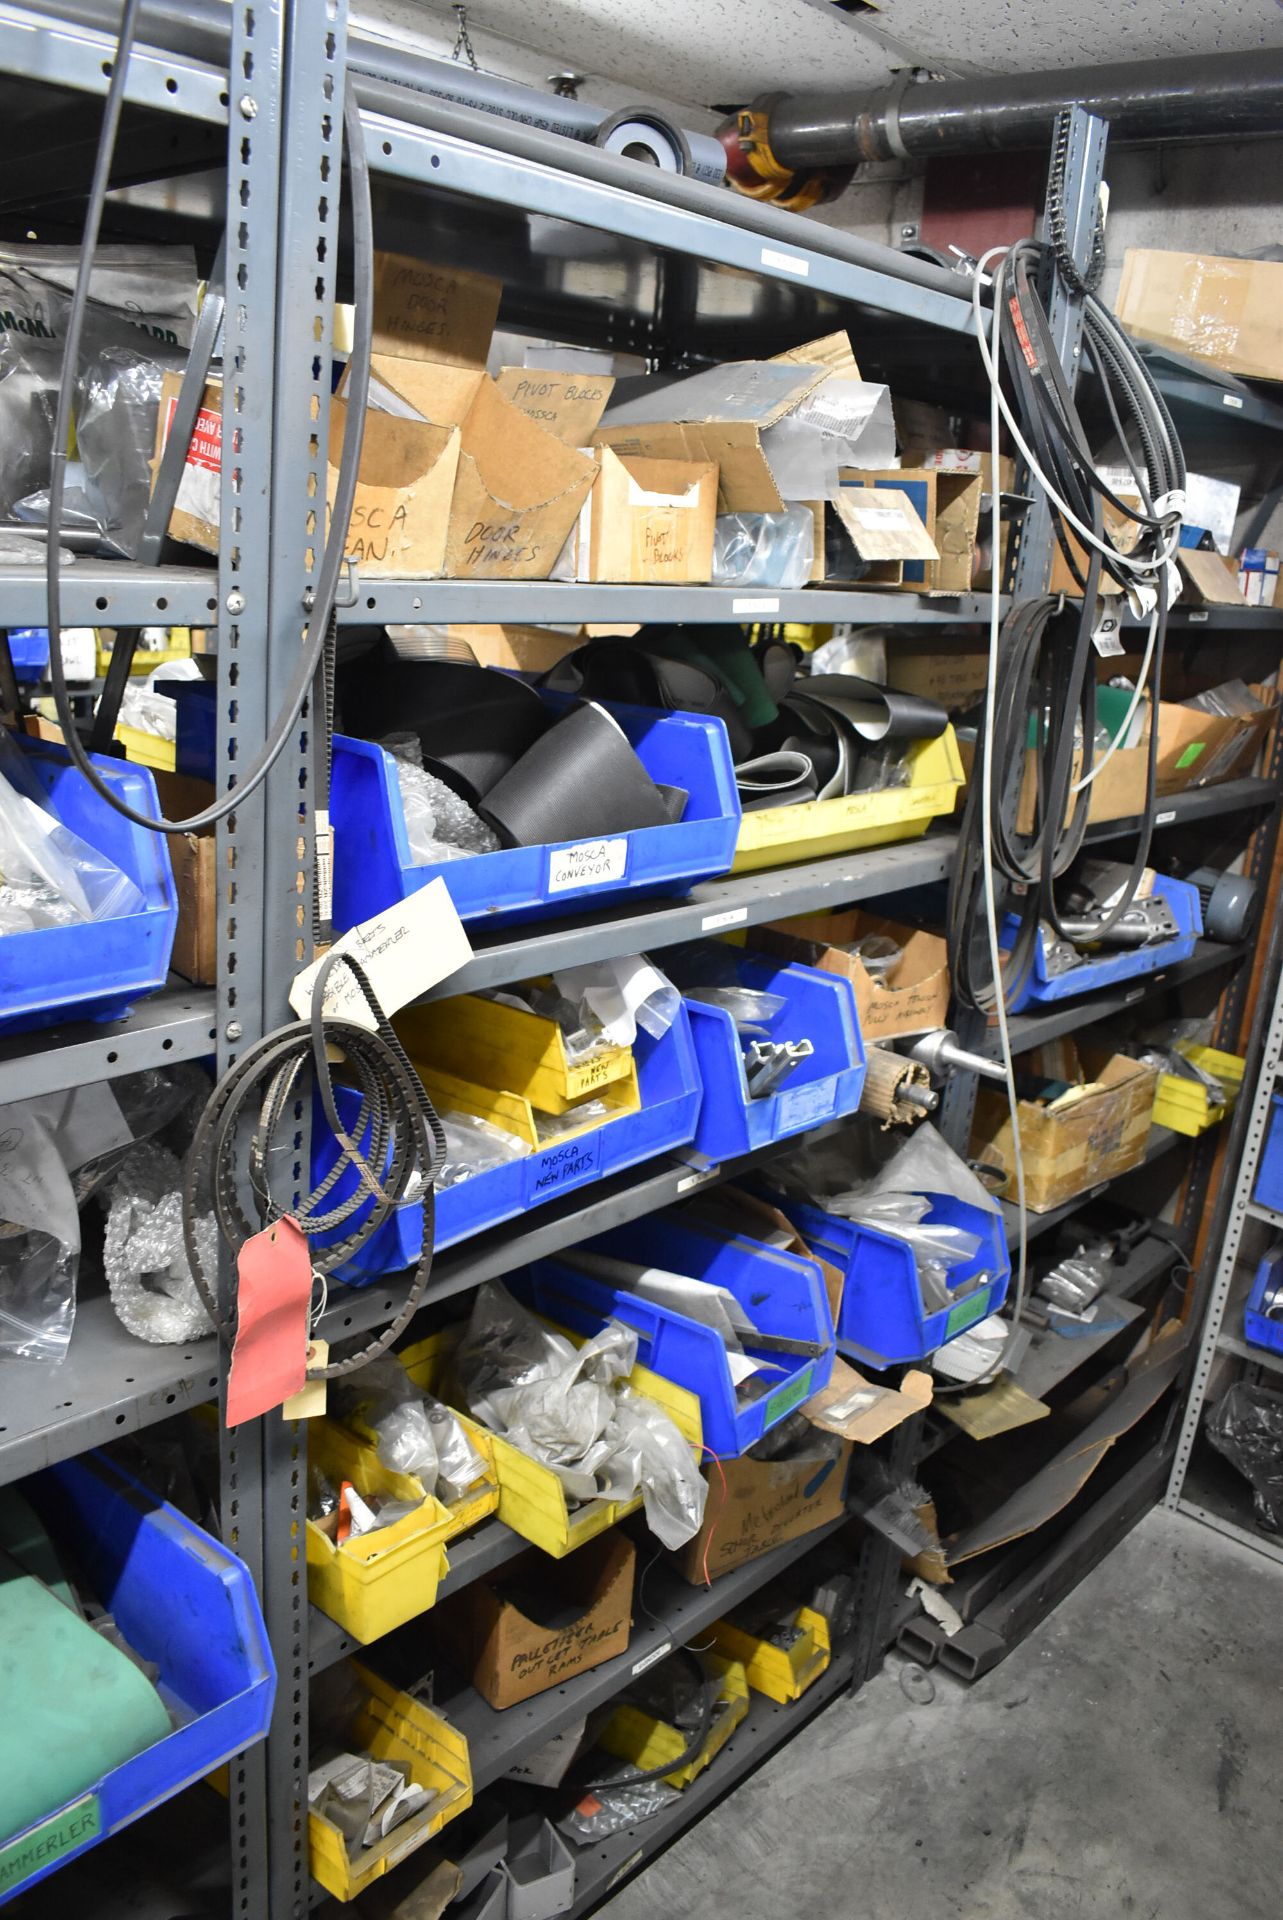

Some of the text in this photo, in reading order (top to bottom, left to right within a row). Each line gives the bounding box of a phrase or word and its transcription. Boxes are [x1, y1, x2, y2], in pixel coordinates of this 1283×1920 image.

[391, 268, 458, 294] MOSCA
[405, 293, 448, 316] DOOR
[512, 379, 561, 401] PIVOT
[464, 522, 520, 545] DOOR
[466, 544, 541, 565] HINGES
[566, 845, 606, 863] MOSCA
[555, 858, 611, 882] CONVEYOR
[591, 1061, 610, 1074] NEW
[580, 1071, 609, 1089] PARTS
[541, 1146, 579, 1169] MOSCA
[535, 1151, 594, 1191] NEW PARTS
[577, 1616, 626, 1650] TABLE
[547, 1653, 583, 1678] RAMS
[0, 1813, 96, 1880] AMMERLER
